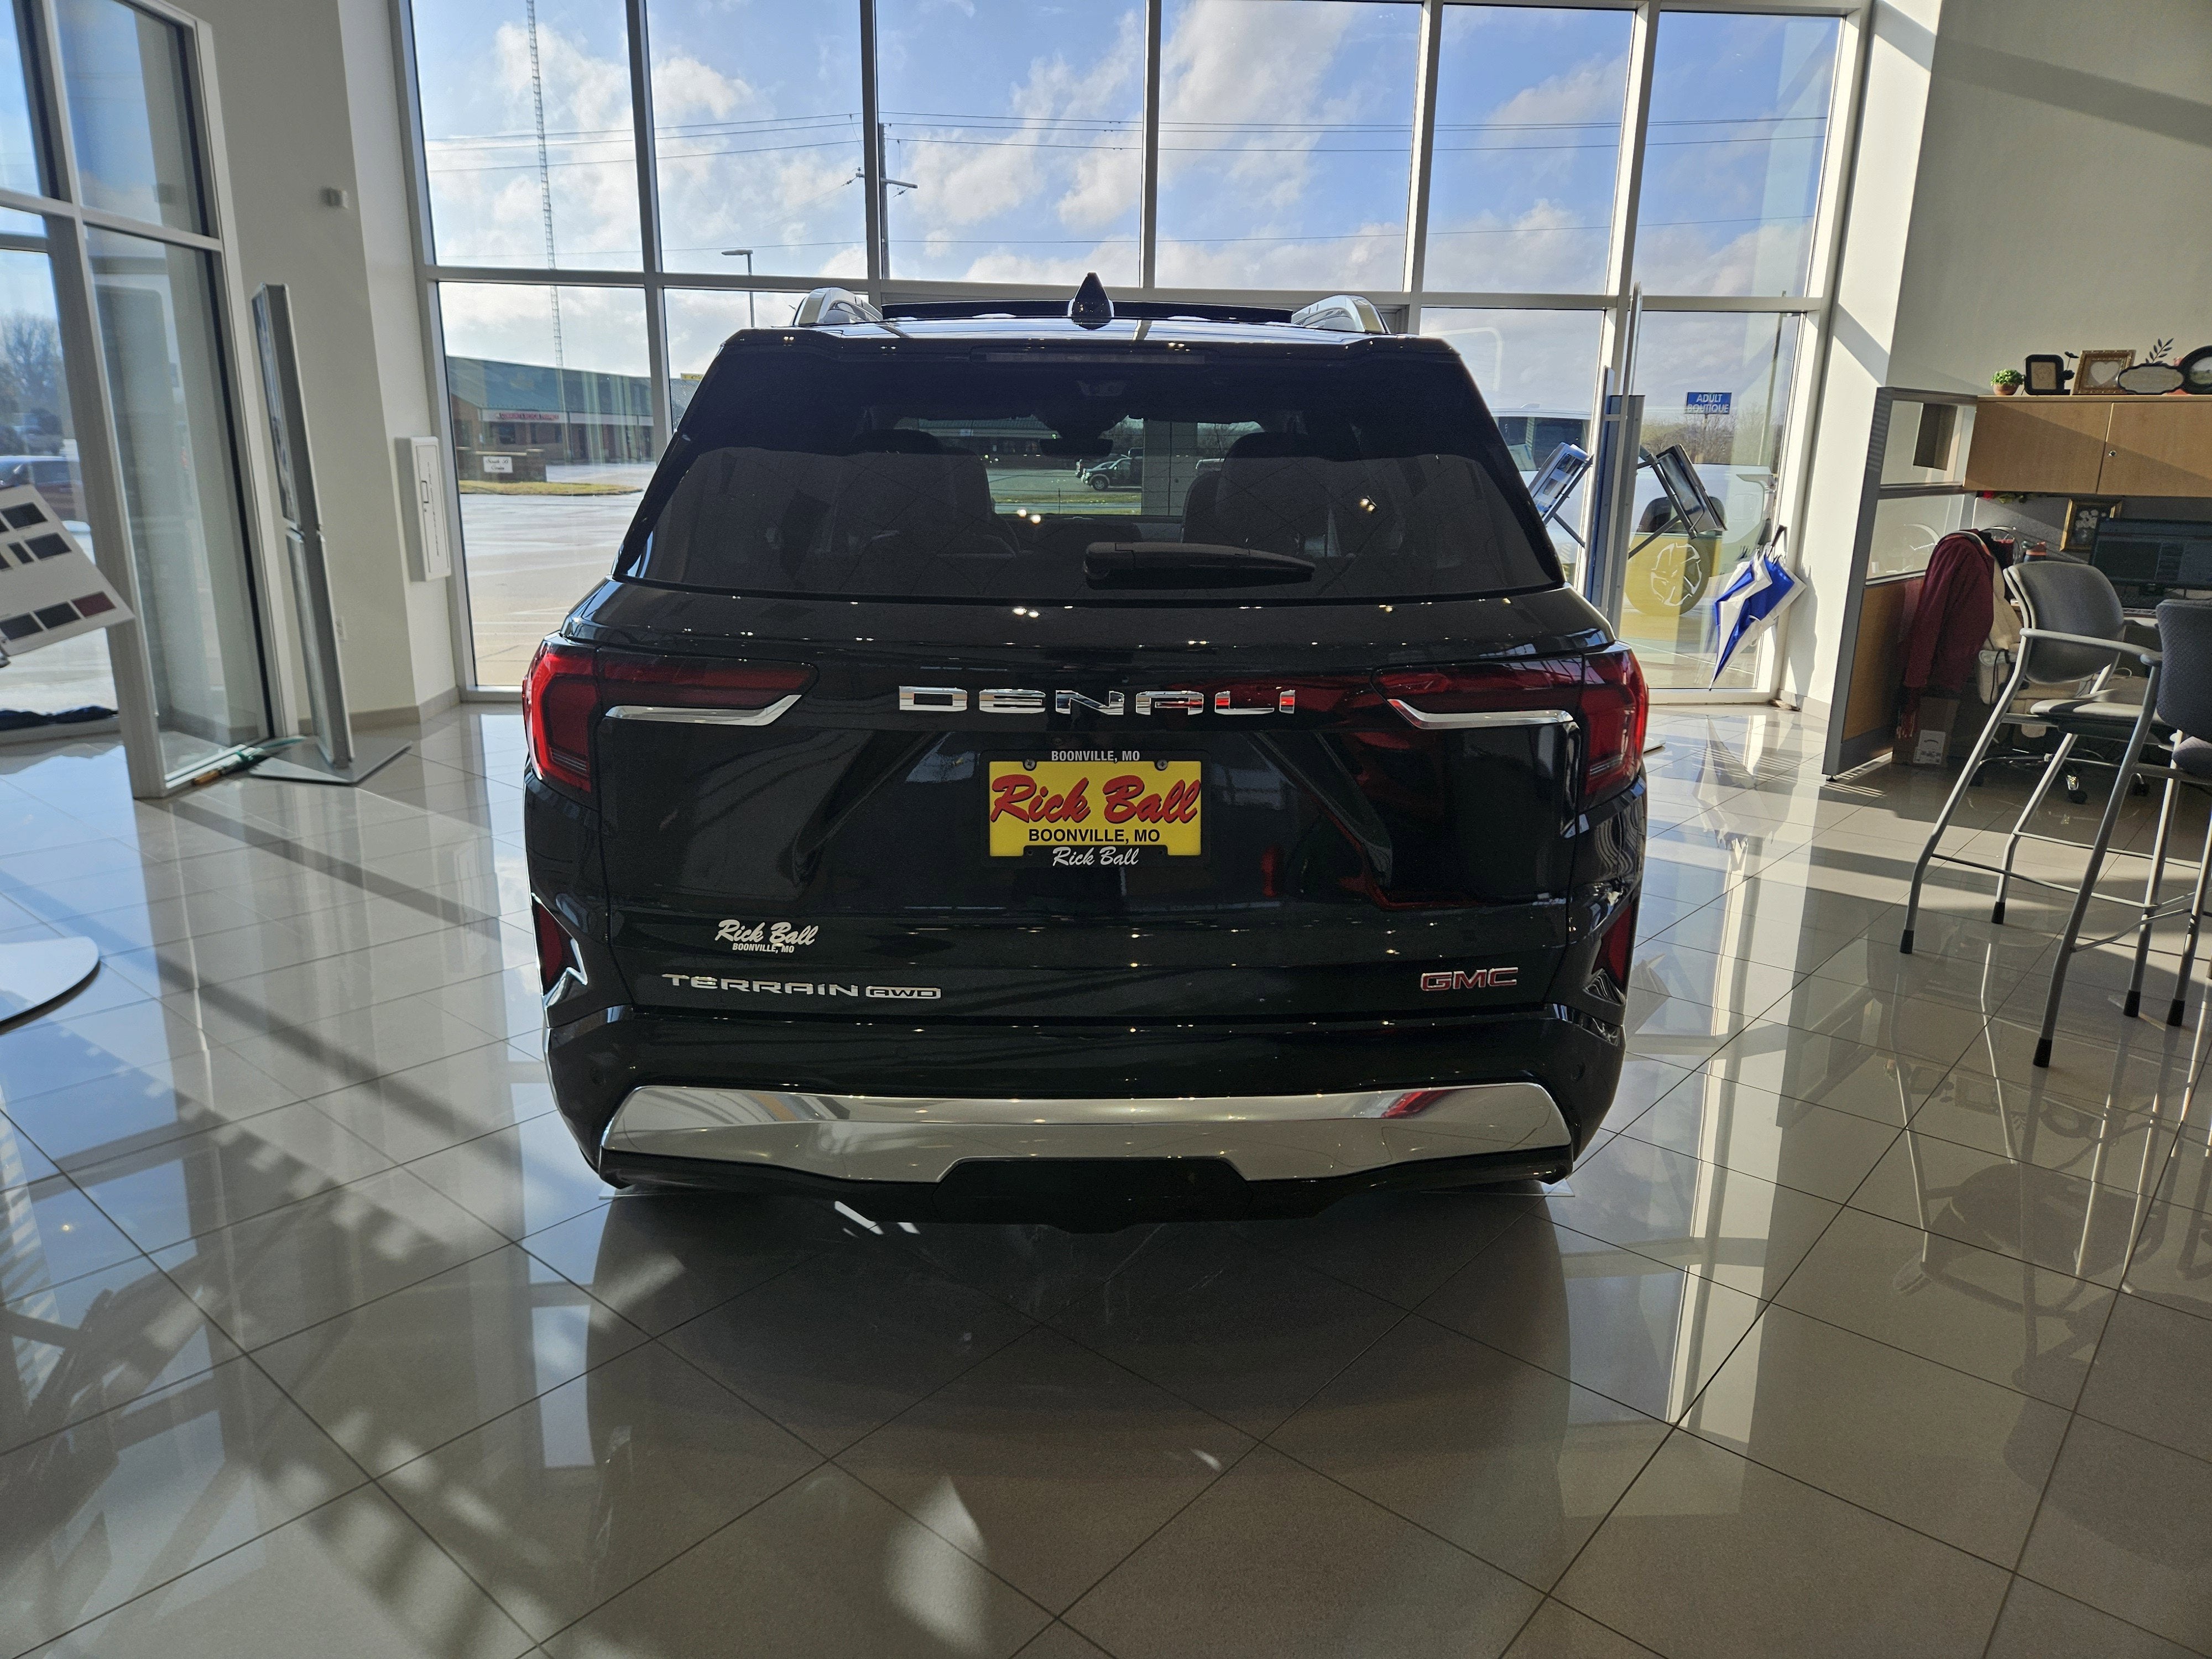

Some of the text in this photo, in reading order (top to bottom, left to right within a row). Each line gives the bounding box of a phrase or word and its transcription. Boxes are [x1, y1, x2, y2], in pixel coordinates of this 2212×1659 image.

[1687, 404, 1729, 413] BOUTIQUE
[1696, 394, 1723, 403] ADULT
[899, 685, 1295, 715] DENALI
[1051, 751, 1140, 762] BOONVILLE, MO
[990, 774, 1201, 823] Rick Ball
[1029, 828, 1160, 844] BOONVILLE, MO
[1052, 846, 1140, 867] Rick Ball
[714, 919, 819, 946] Rick Ball
[732, 943, 795, 953] BOONVILLE, MO
[662, 973, 939, 998] TERRAIN AWD
[1421, 967, 1518, 991] GMC
